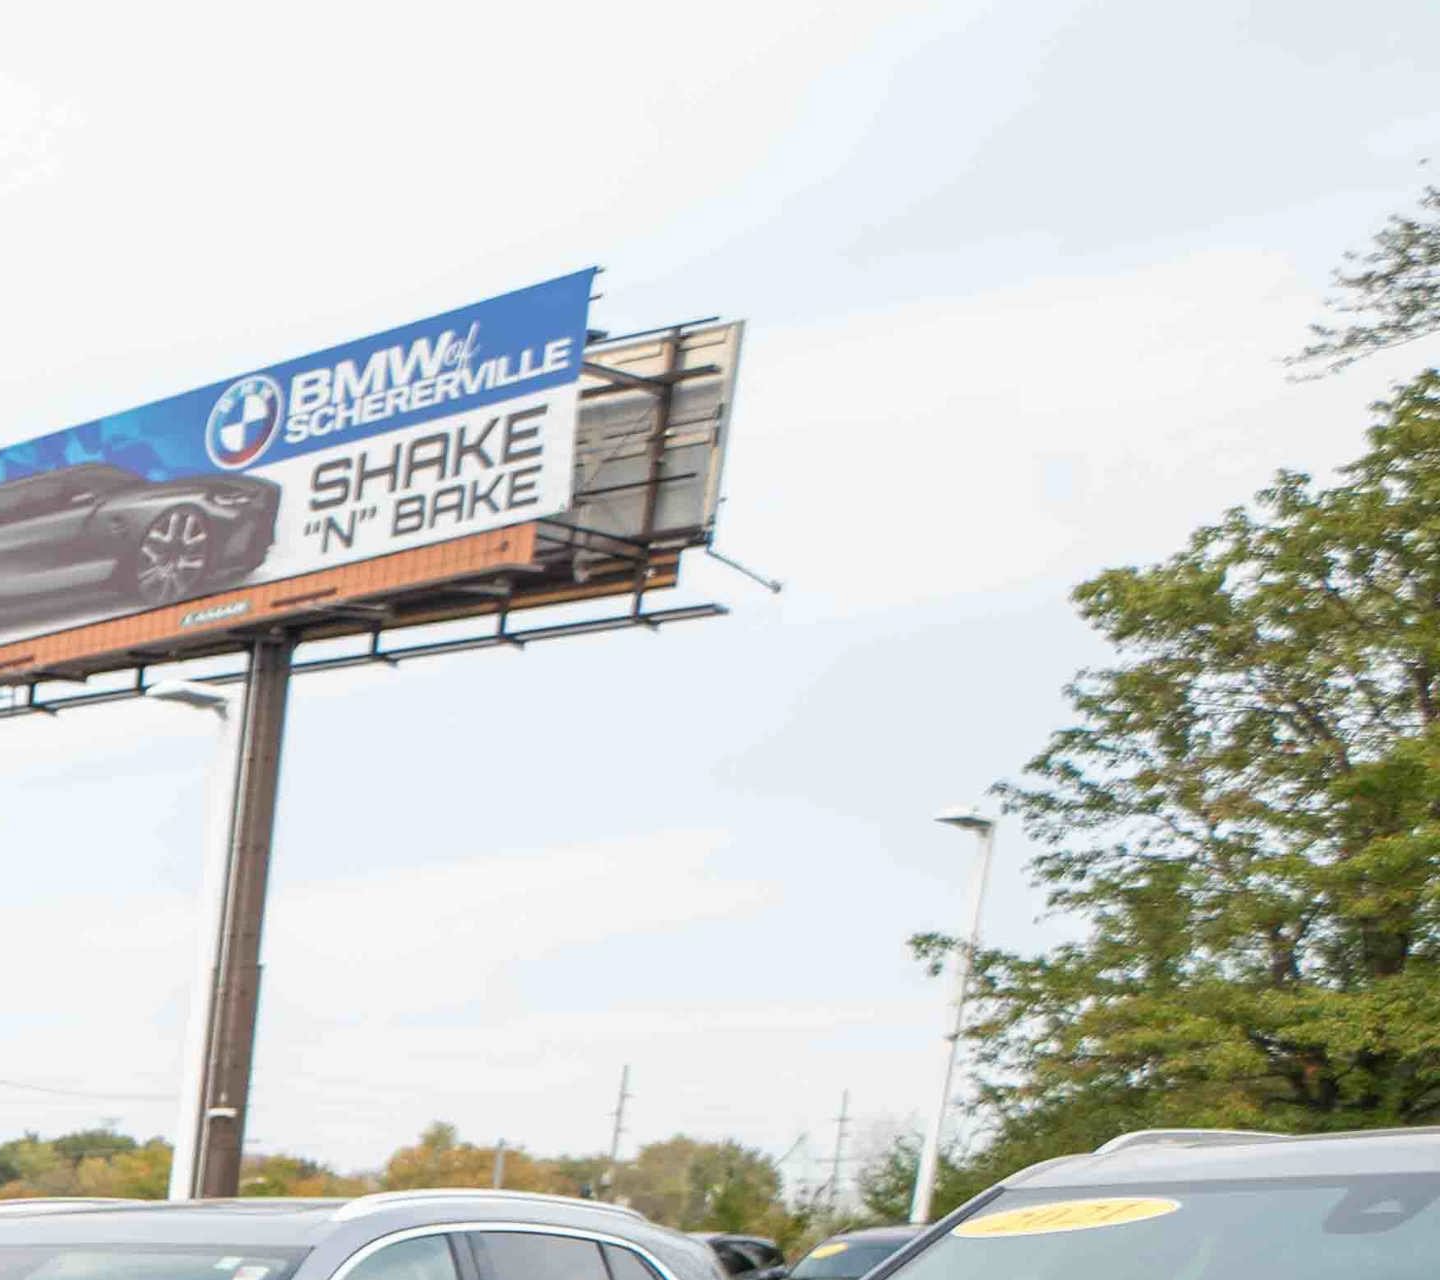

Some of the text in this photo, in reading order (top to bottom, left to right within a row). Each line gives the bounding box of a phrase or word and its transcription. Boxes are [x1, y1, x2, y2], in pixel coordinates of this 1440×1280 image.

[284, 336, 575, 446] SCHERERVILLE
[288, 320, 482, 416] BMW of
[309, 403, 550, 513] SHAKE
[390, 464, 544, 538] BAKE
